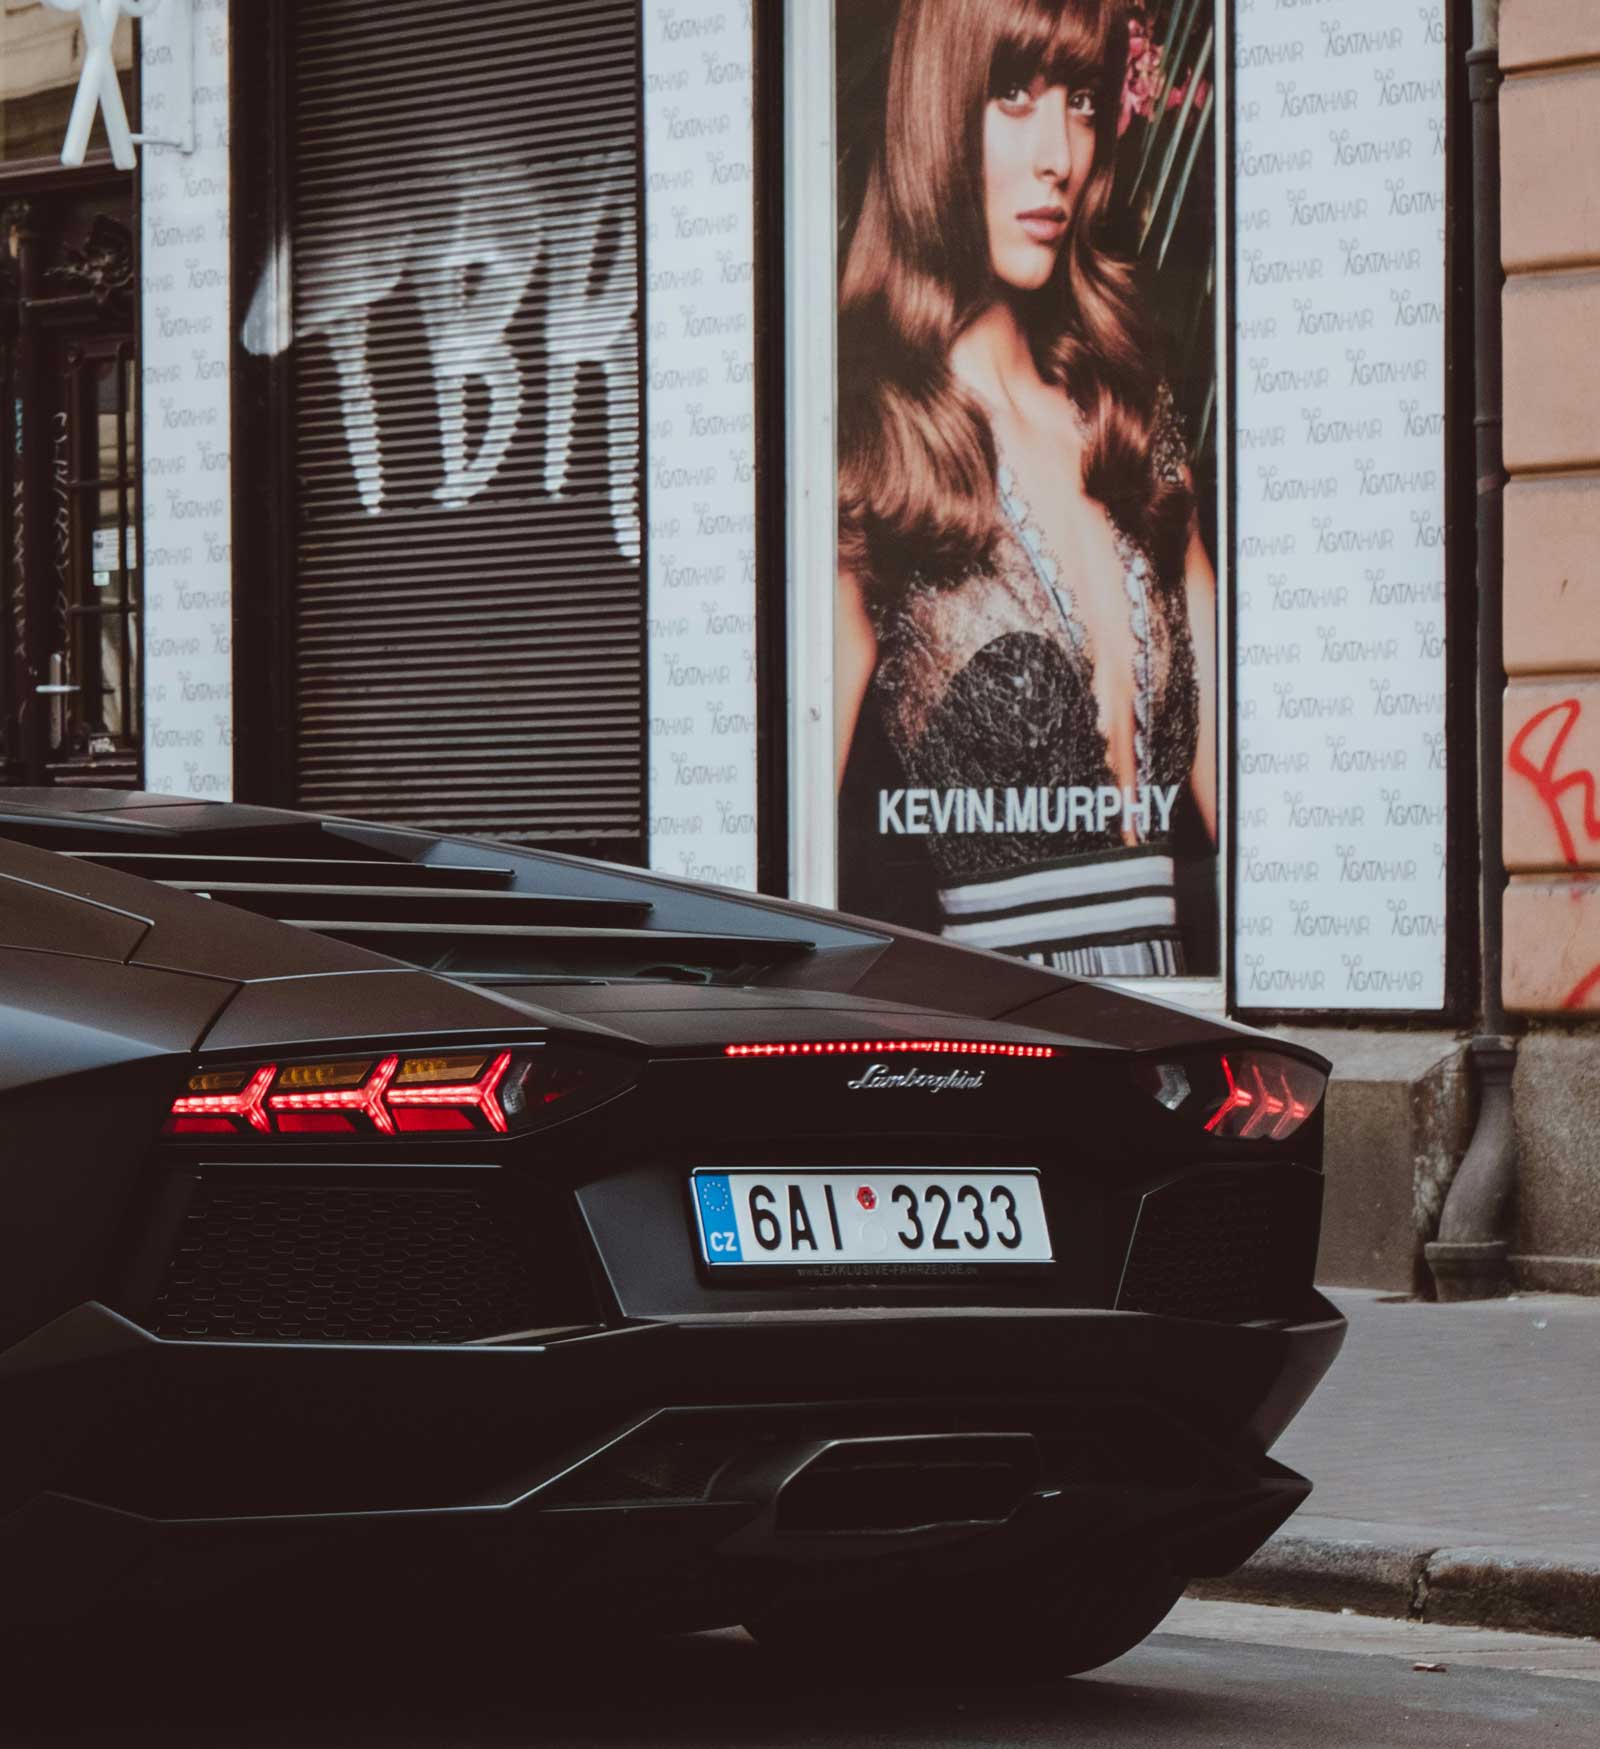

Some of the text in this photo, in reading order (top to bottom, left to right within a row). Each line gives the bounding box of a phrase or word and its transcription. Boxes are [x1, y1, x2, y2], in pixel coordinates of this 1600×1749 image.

[878, 784, 1180, 834] KEVIN.MURPHY
[848, 1064, 985, 1093] Lamborghini
[749, 1184, 1022, 1251] 6AI 3233
[710, 1231, 737, 1252] CZ
